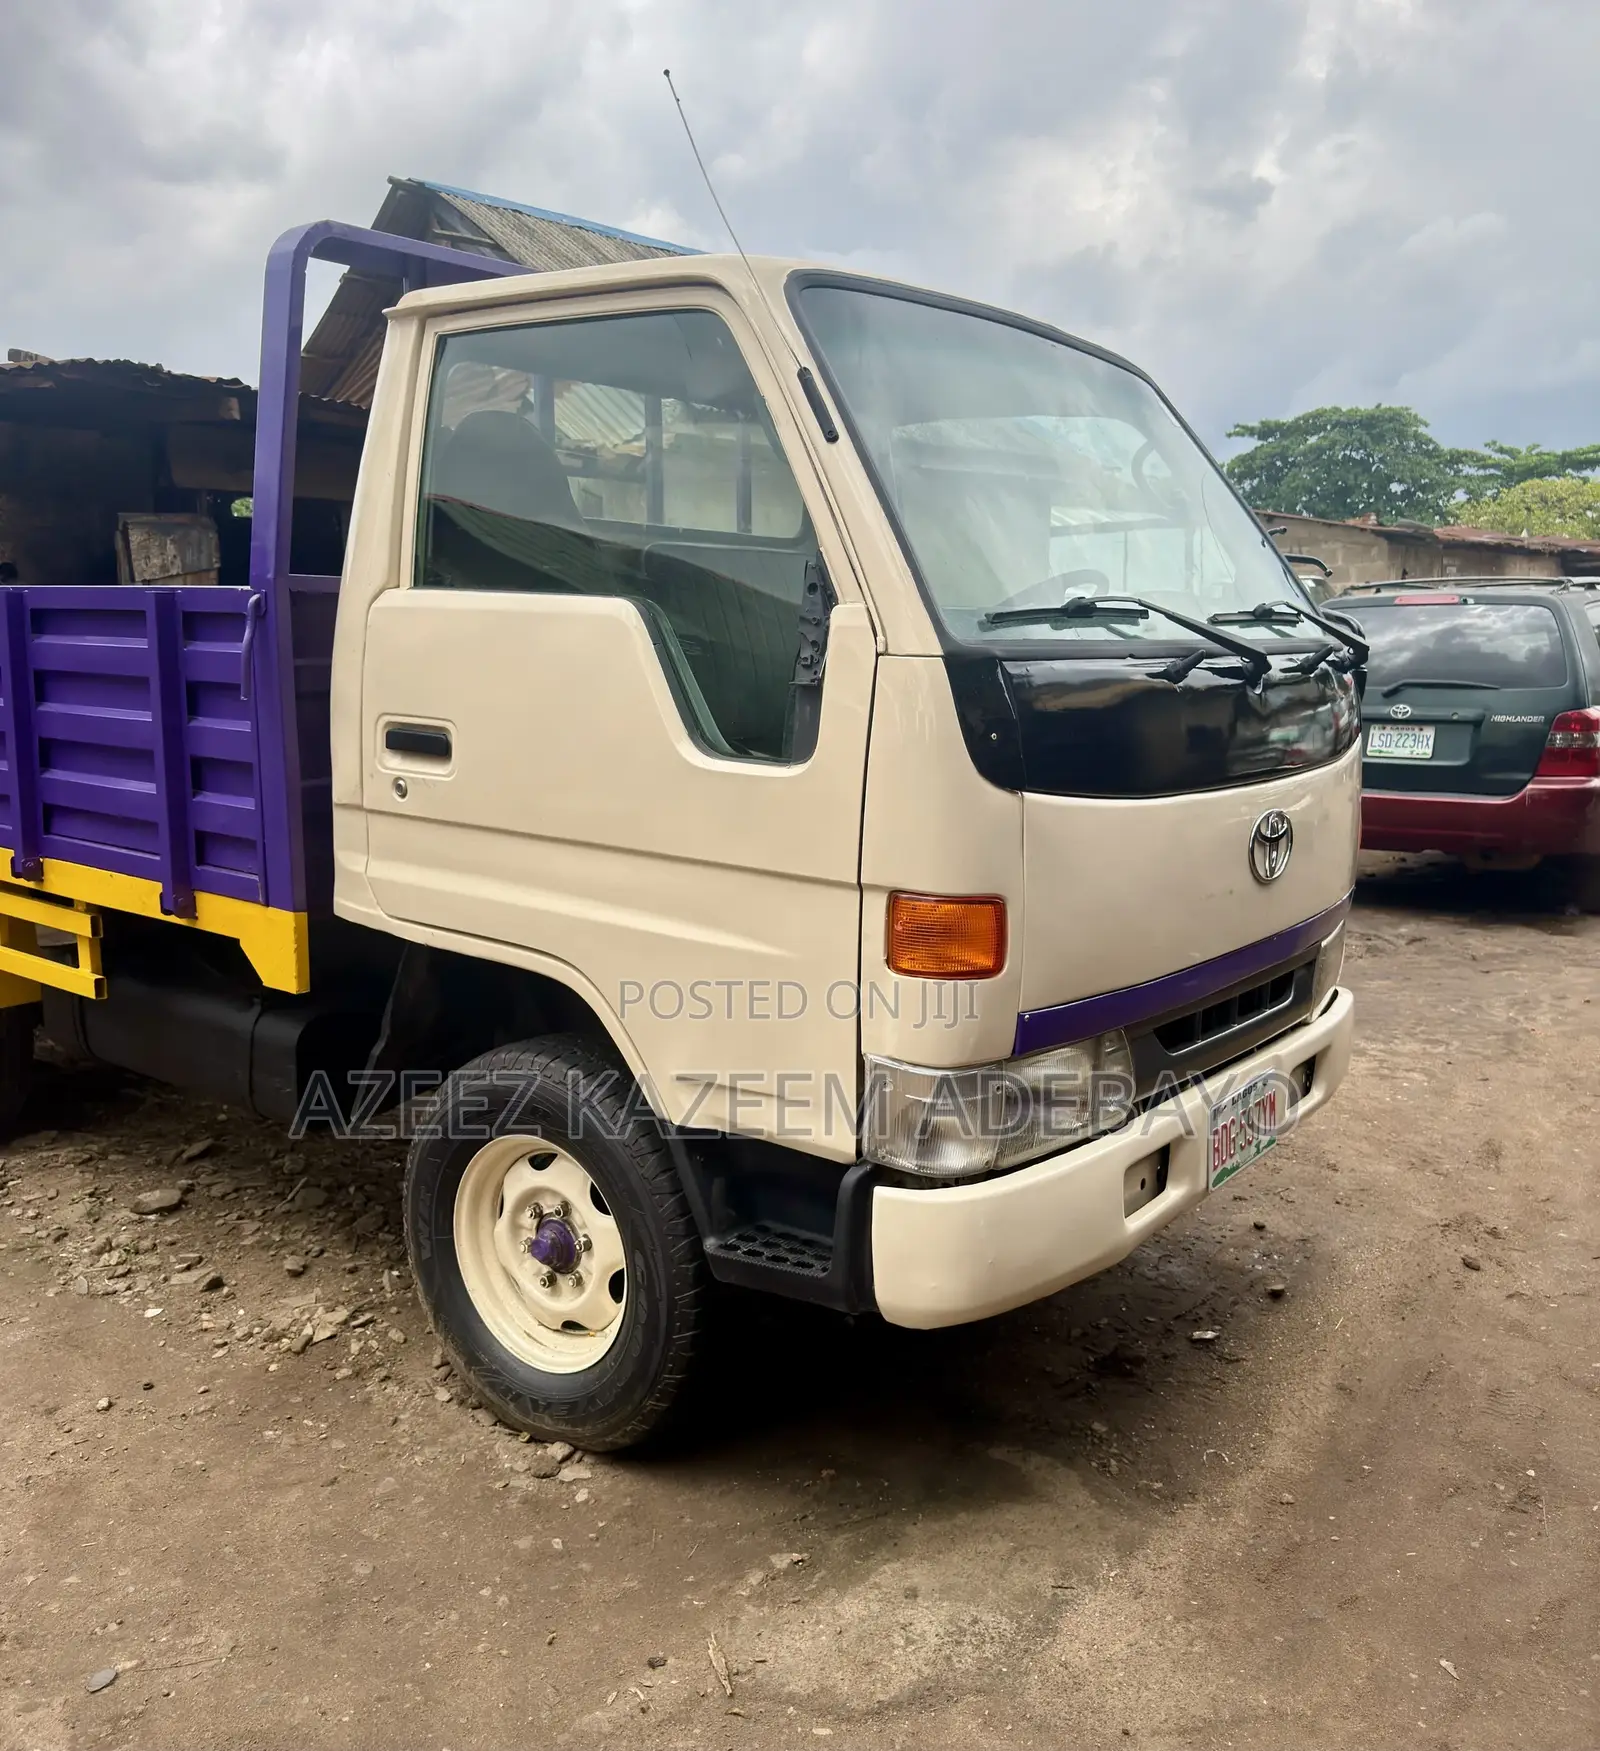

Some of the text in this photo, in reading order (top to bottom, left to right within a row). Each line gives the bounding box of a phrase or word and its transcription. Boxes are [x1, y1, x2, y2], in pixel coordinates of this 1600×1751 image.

[1490, 714, 1545, 723] HIGHLANDER
[1370, 732, 1431, 751] LSD-223HX
[1231, 1082, 1258, 1107] LAGOS
